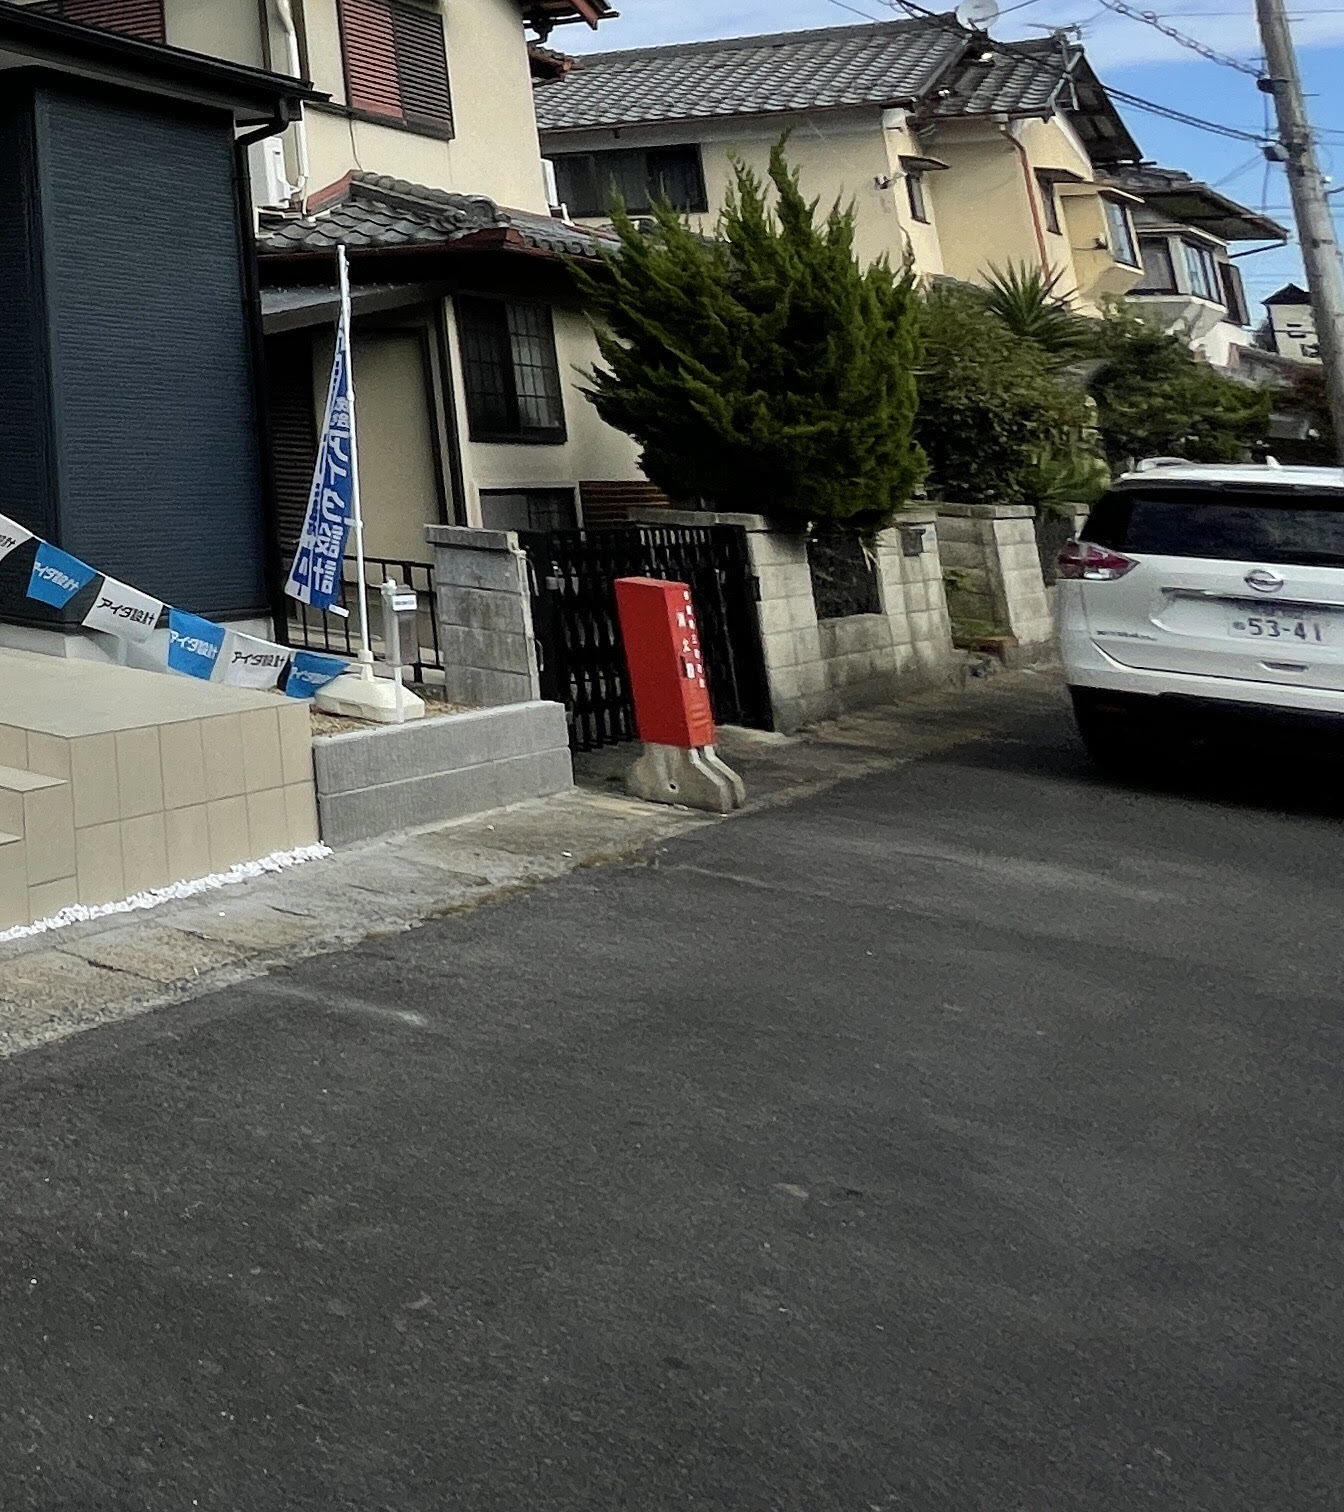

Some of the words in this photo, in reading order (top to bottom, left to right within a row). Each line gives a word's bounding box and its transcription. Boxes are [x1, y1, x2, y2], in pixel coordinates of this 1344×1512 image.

[96, 596, 157, 626] アイダ設計
